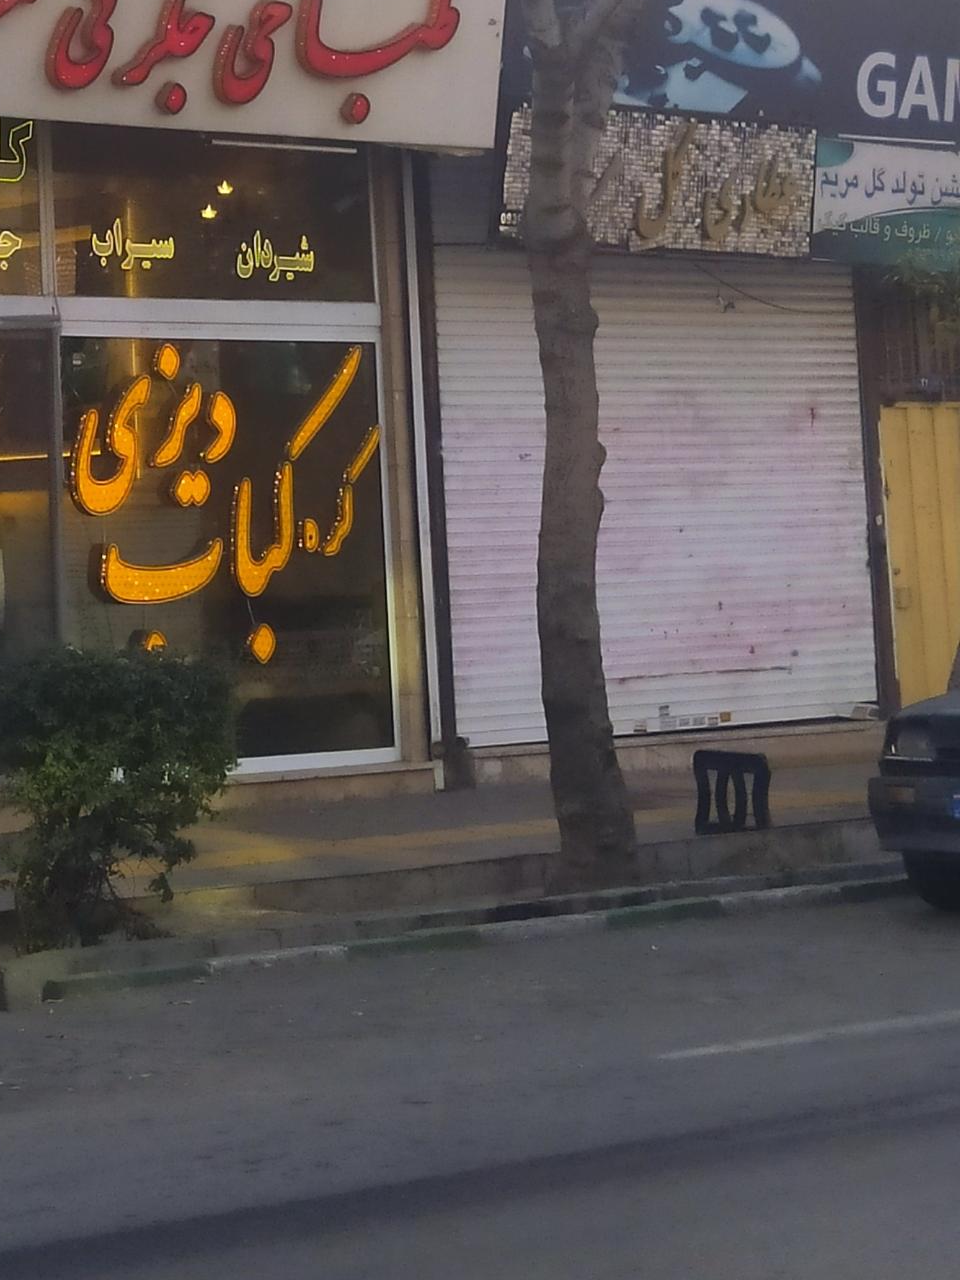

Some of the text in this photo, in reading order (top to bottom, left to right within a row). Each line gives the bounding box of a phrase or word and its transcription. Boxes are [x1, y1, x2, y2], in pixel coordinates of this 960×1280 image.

[820, 167, 960, 206] شن تولد گل مریم
[90, 217, 176, 270] سیراب
[849, 217, 881, 239] قالب
[894, 219, 931, 244] ظروف
[235, 229, 316, 282] شیردان
[71, 343, 237, 516] دیزی
